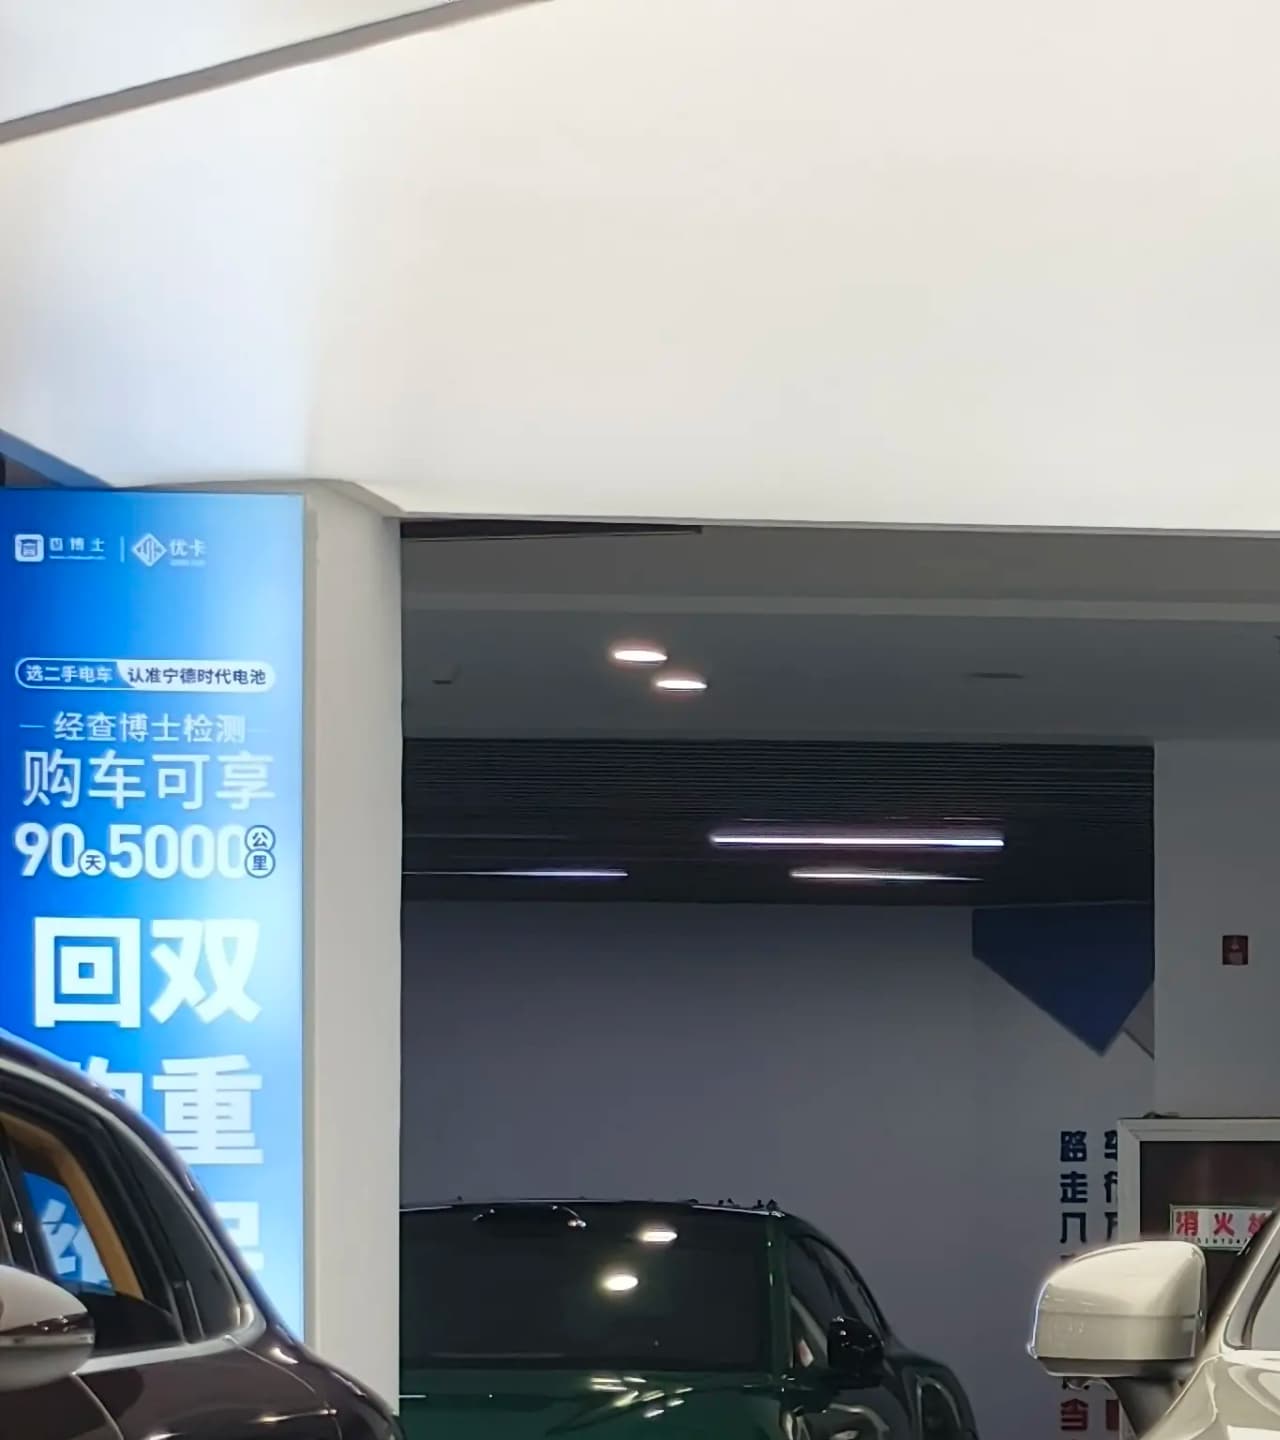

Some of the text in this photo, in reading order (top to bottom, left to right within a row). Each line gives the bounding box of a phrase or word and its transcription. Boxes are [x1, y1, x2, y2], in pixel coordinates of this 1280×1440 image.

[25, 663, 266, 686] 选二手电车 认准宁德时代电池
[53, 710, 247, 744] 经查博士检测
[22, 748, 275, 811] 购车可享
